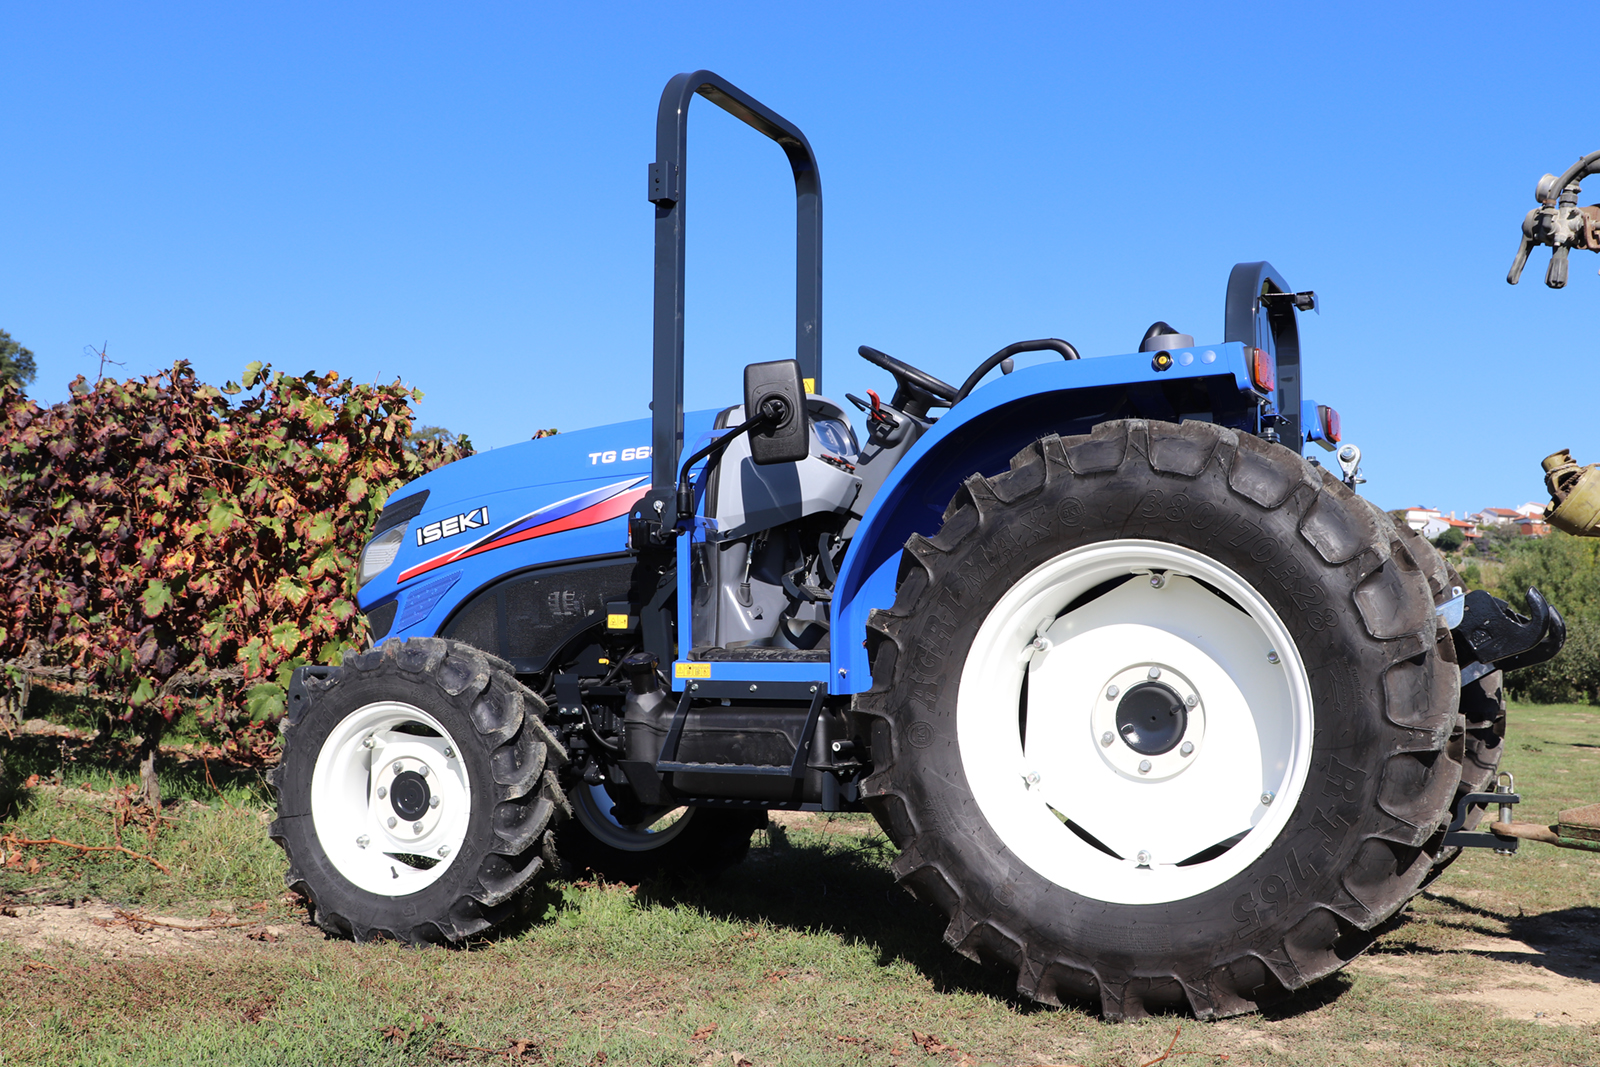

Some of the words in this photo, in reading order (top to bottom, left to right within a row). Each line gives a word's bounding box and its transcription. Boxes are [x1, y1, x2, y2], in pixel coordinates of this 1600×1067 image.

[588, 452, 617, 465] TG
[621, 446, 653, 461] 66
[416, 506, 490, 547] ISEKI
[1140, 488, 1338, 632] 380/70R28
